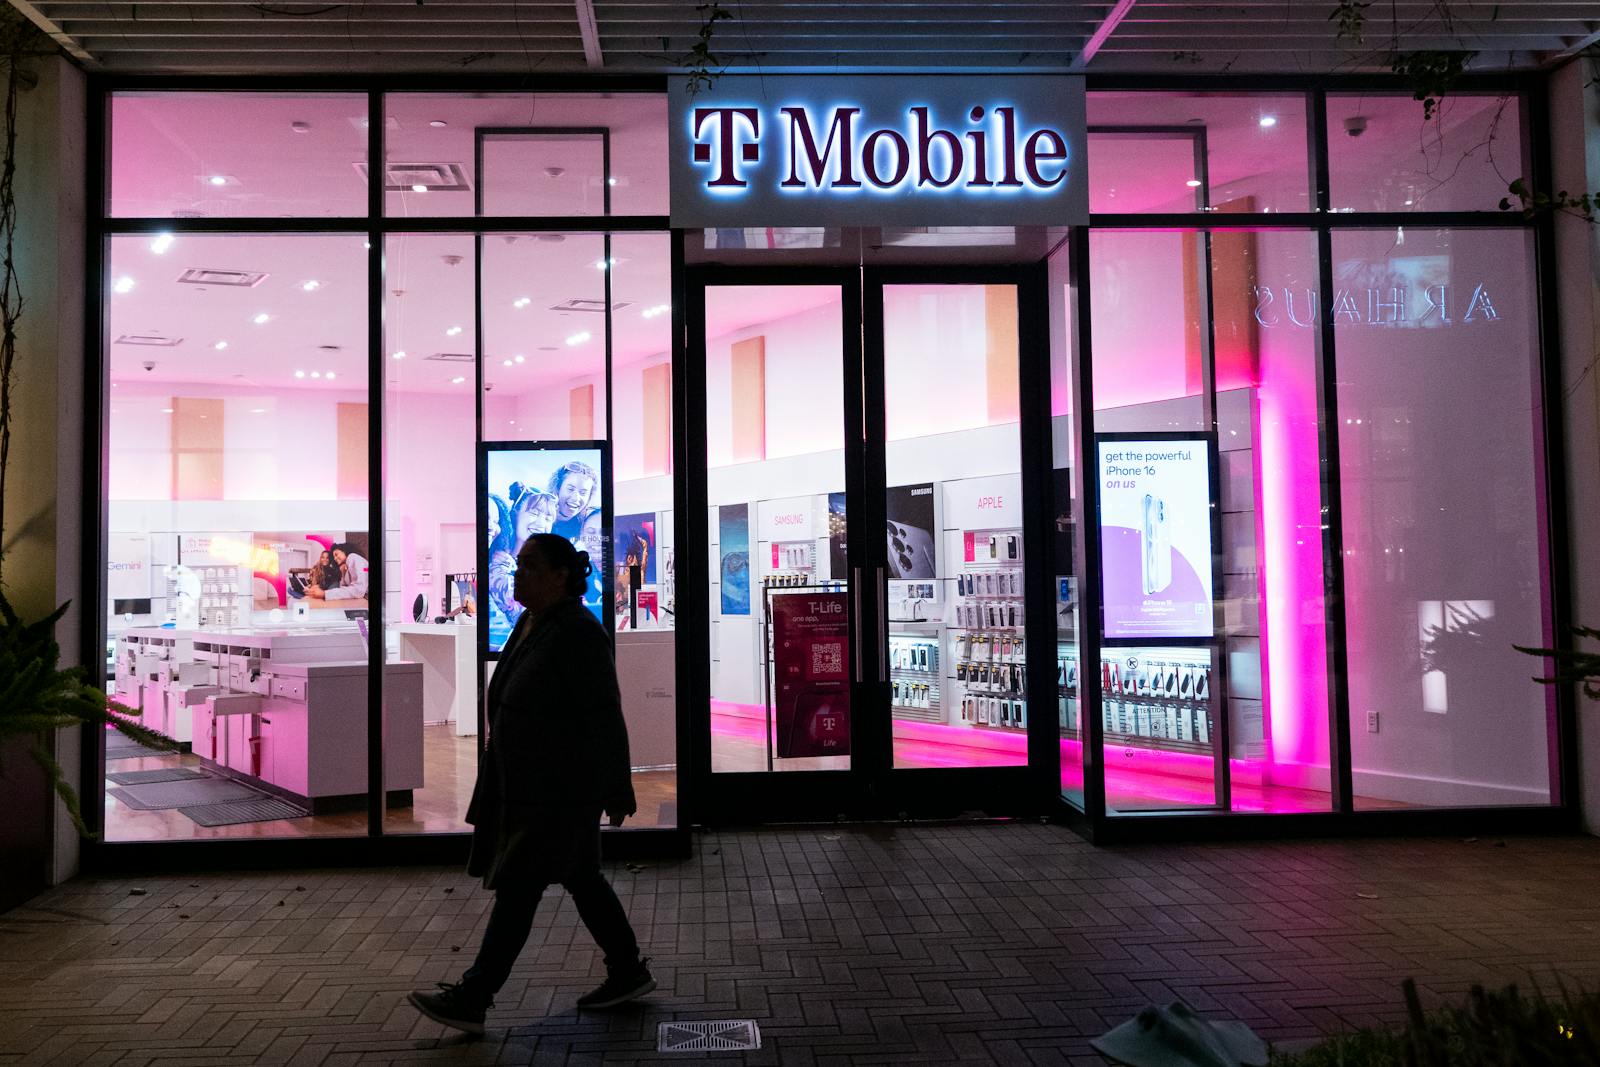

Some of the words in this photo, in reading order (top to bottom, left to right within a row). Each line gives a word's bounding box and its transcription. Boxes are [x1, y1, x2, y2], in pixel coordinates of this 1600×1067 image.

[780, 105, 1067, 188] Mobile
[1105, 453, 1124, 463] get
[1126, 452, 1143, 461] the
[1145, 451, 1192, 462] powerful
[1106, 466, 1142, 476] iPhone
[1144, 466, 1156, 475] 16
[1106, 480, 1121, 489] on
[1123, 480, 1136, 489] us
[911, 487, 932, 496] SAMSUNG
[977, 496, 1003, 509] APPLE
[774, 514, 803, 526] SAMSUNG
[808, 601, 842, 614] T-Life
